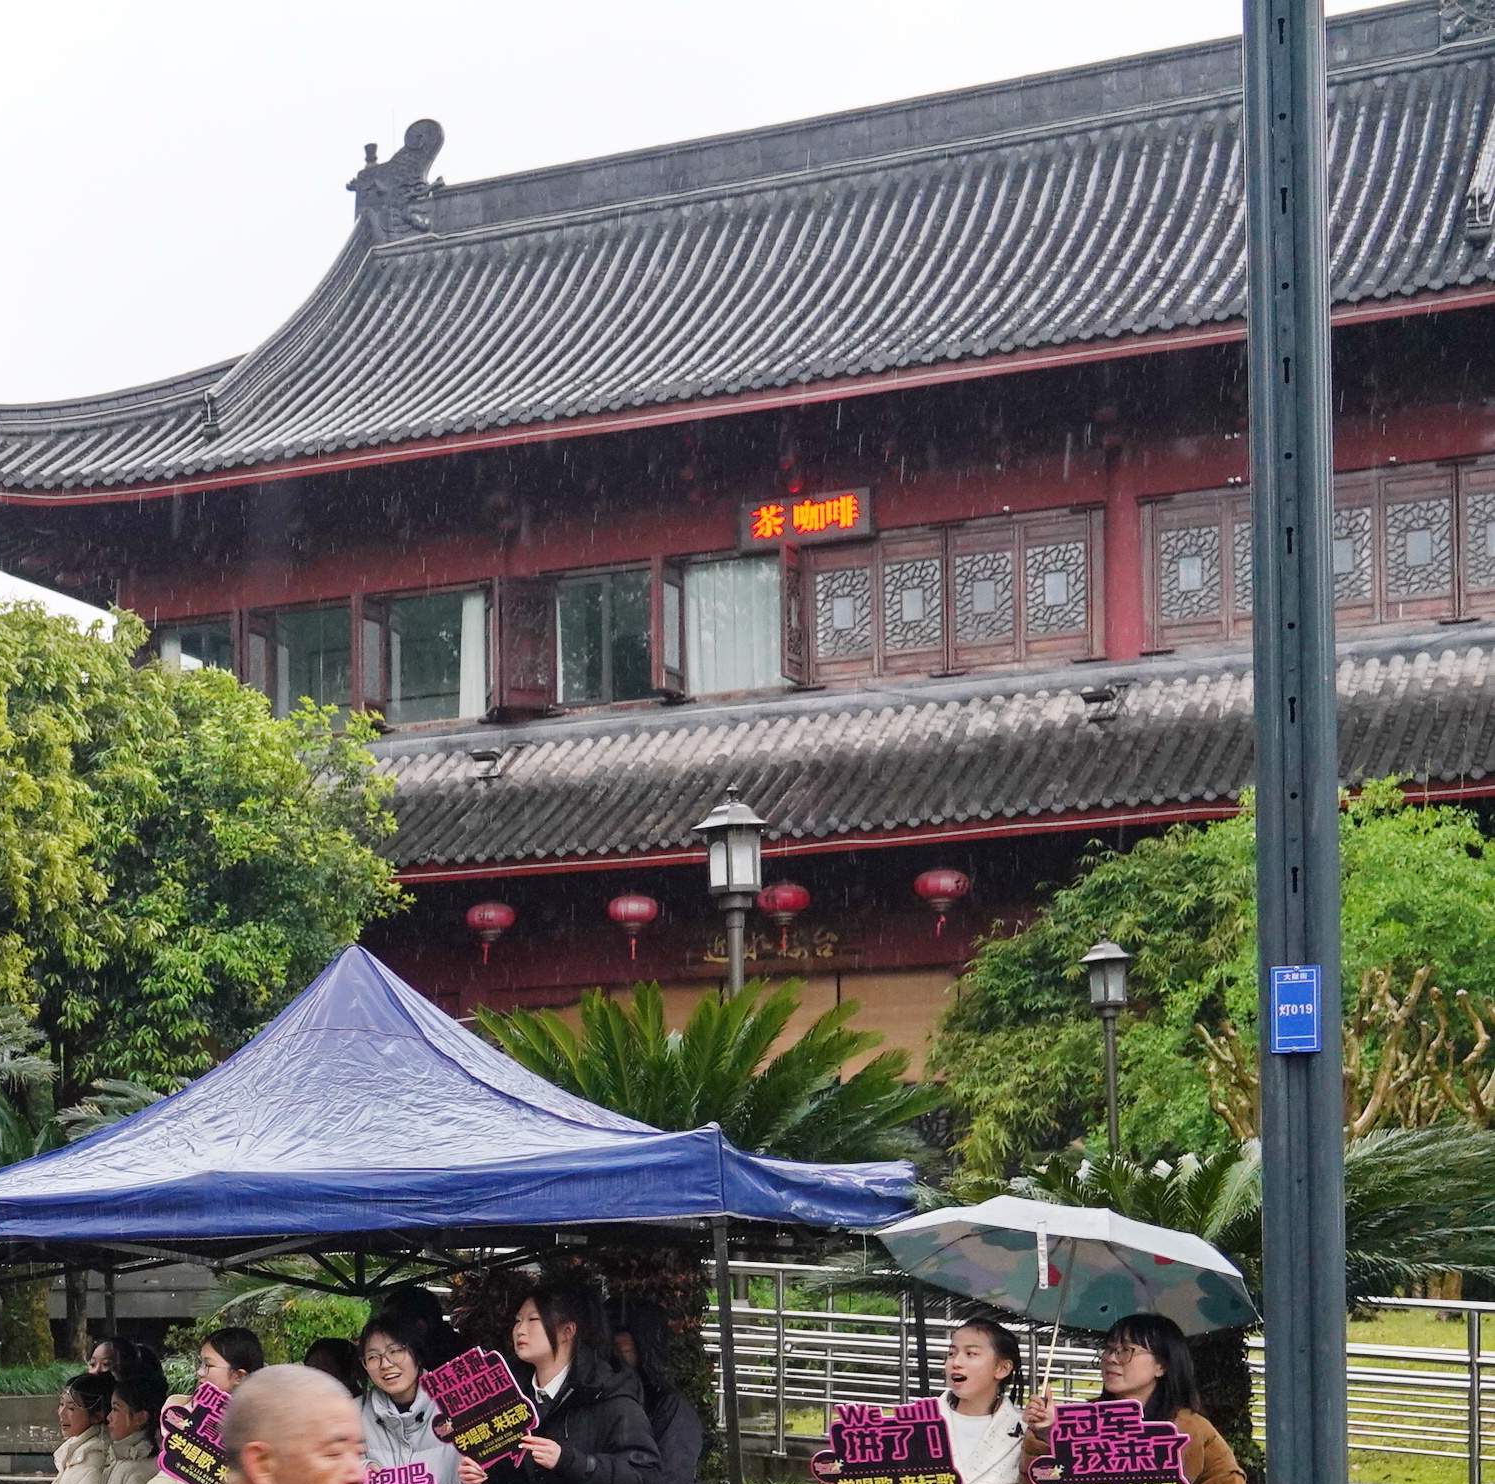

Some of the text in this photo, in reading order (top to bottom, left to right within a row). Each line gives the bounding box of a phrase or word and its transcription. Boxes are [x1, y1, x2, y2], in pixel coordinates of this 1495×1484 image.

[750, 494, 860, 539] 茶 咖啡
[1279, 1003, 1313, 1016] 灯019
[455, 1422, 494, 1451] 学唱歌
[491, 1403, 532, 1433] 来耘歌
[836, 1398, 940, 1426] We will
[1056, 1403, 1143, 1438] 冠军
[167, 1433, 216, 1472] 学唱歌
[1072, 1437, 1190, 1474] 我来了
